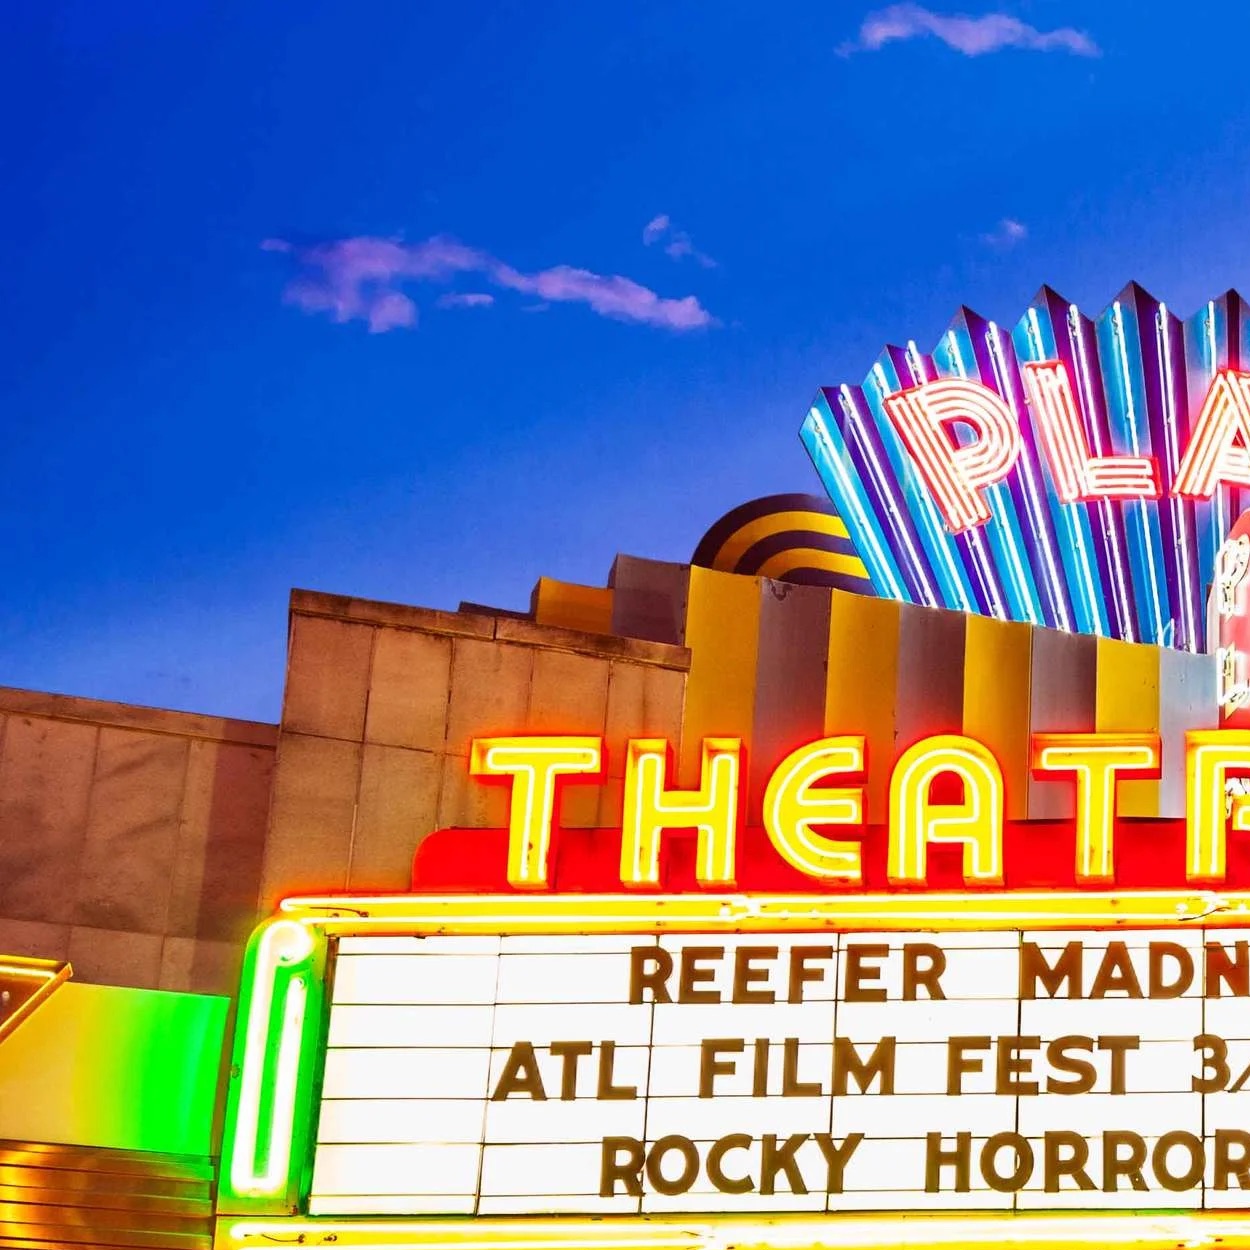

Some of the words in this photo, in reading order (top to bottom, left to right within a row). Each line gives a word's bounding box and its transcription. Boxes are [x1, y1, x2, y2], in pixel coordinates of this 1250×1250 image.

[630, 943, 946, 1004] REEFER
[491, 1040, 637, 1101] ATL
[699, 1036, 896, 1098] FILM
[946, 1033, 1140, 1096] FEST
[600, 1132, 865, 1197] ROCKY
